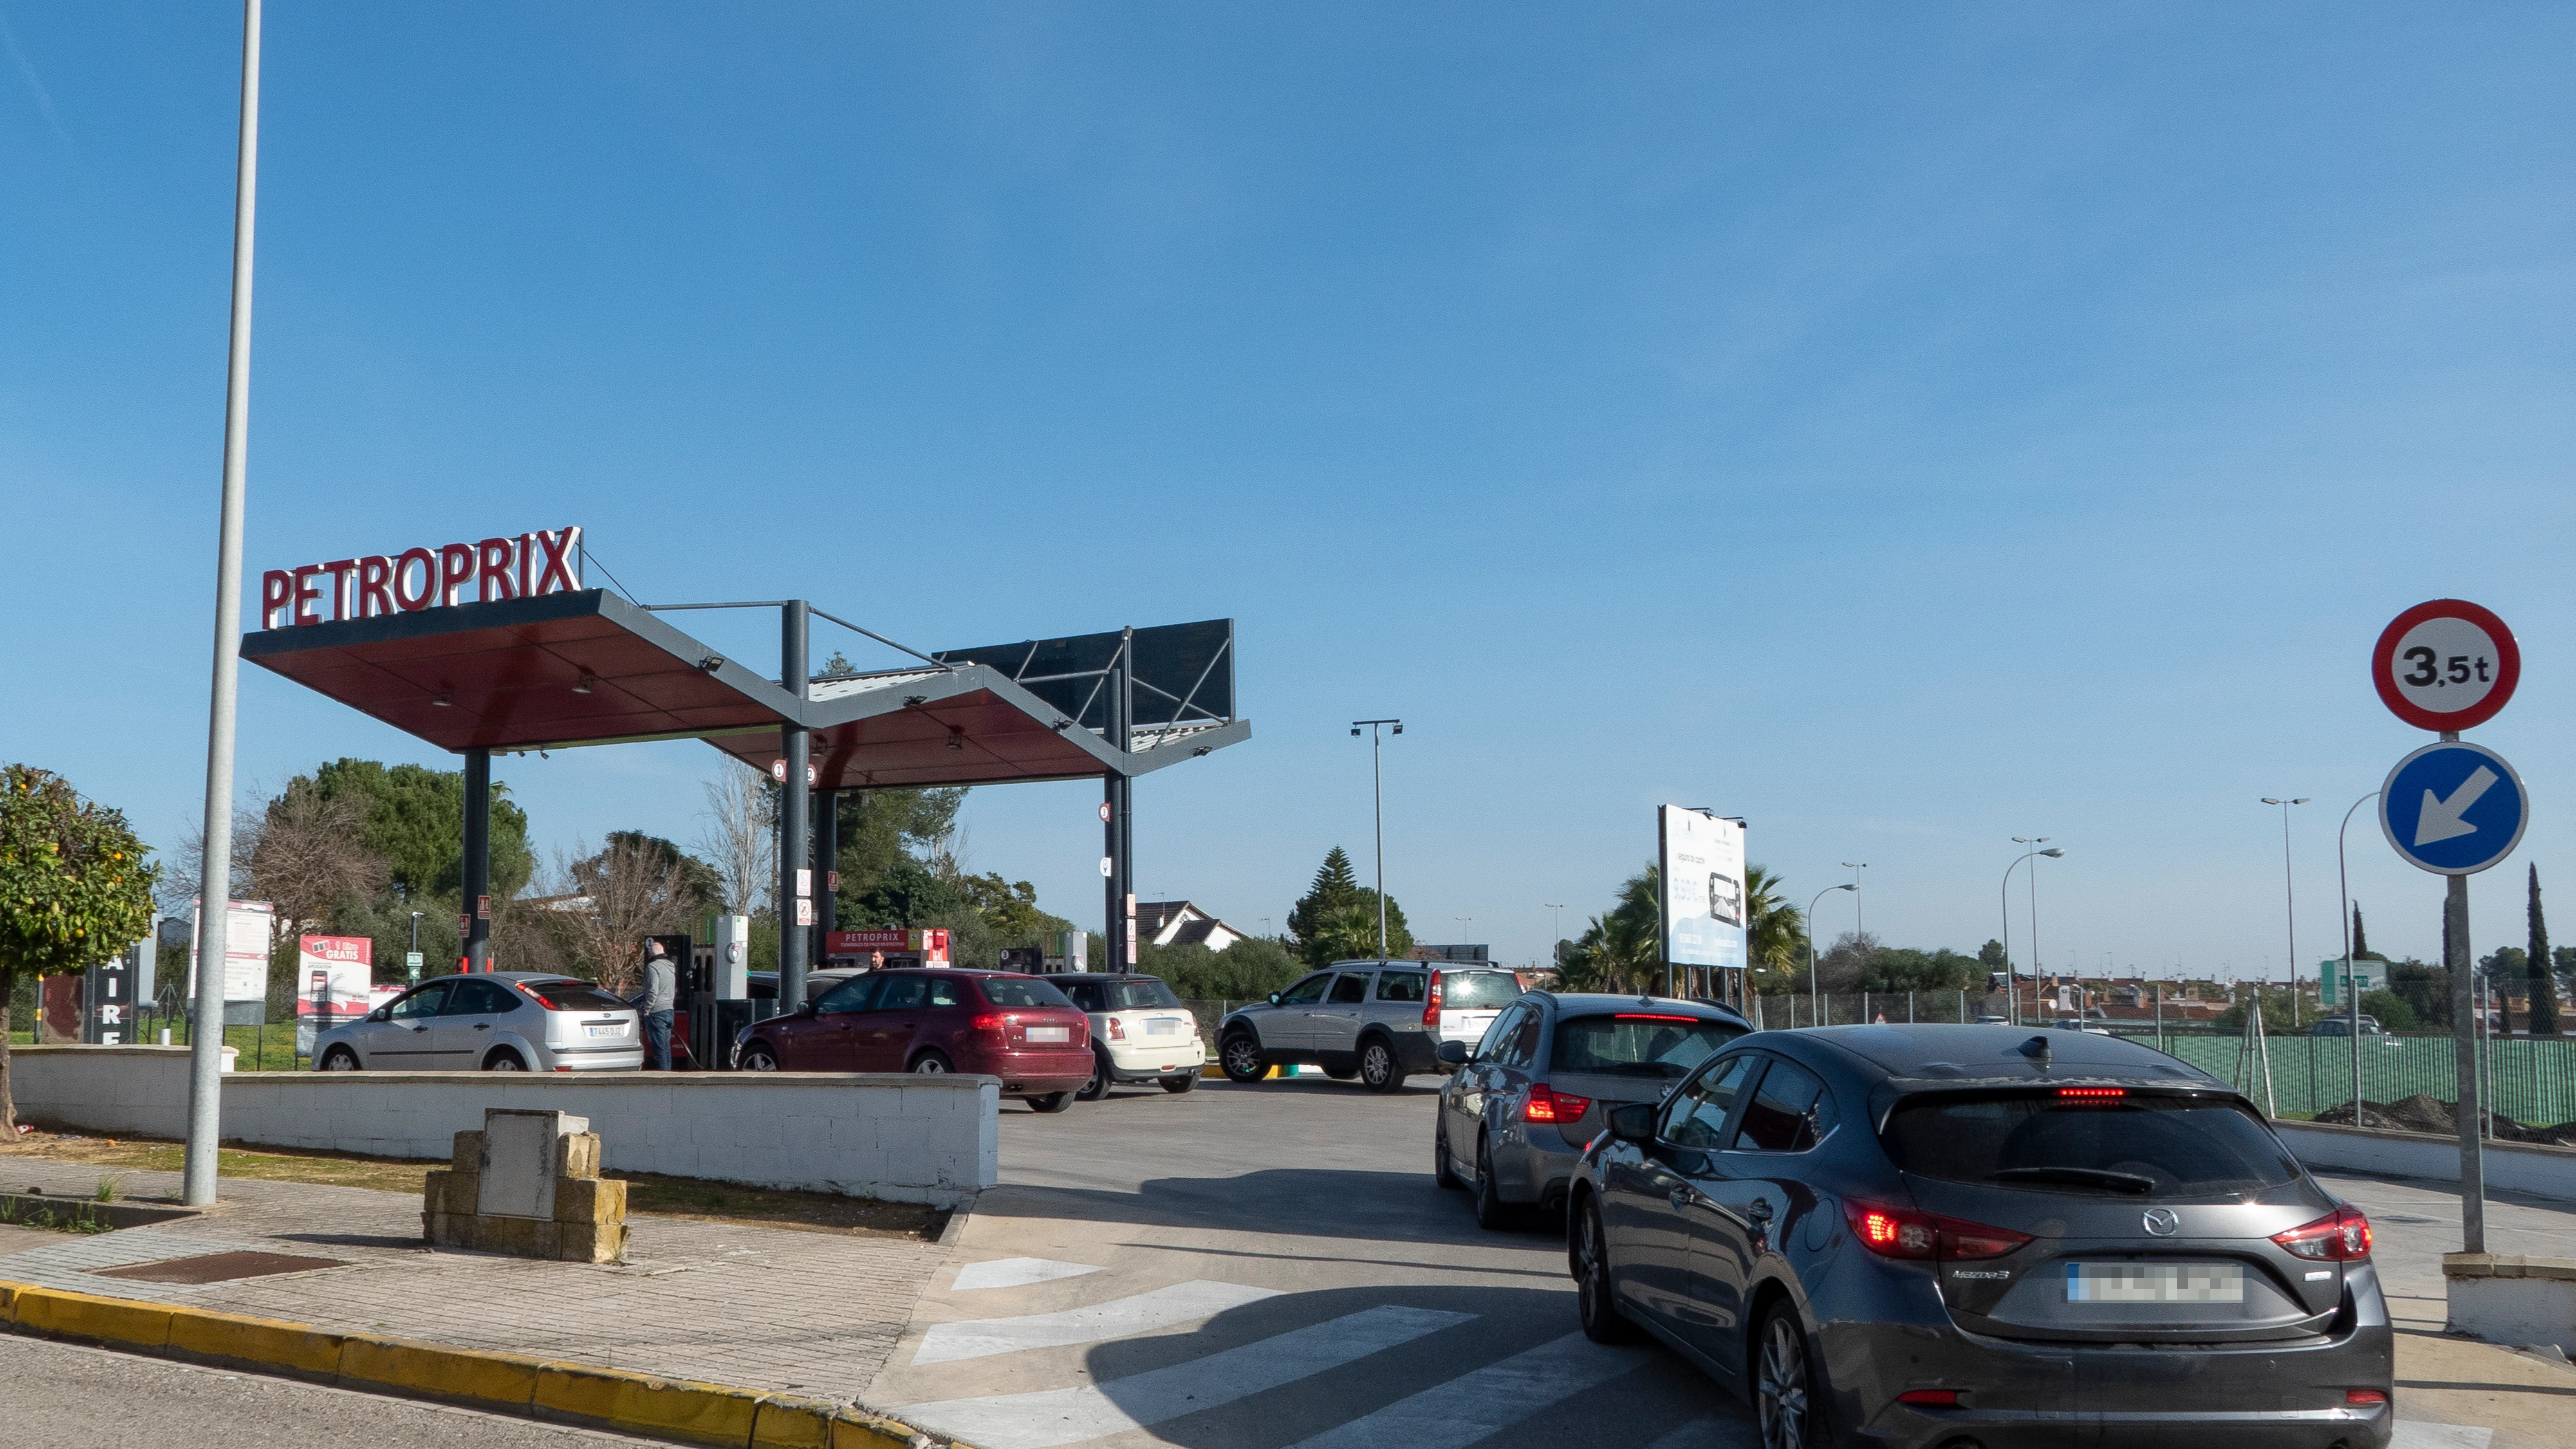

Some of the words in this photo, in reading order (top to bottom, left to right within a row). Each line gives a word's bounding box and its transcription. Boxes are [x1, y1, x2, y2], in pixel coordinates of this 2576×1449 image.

[263, 526, 581, 629] PETROPRIX
[846, 934, 899, 942] PETROPRIX
[326, 949, 358, 960] GRATIS
